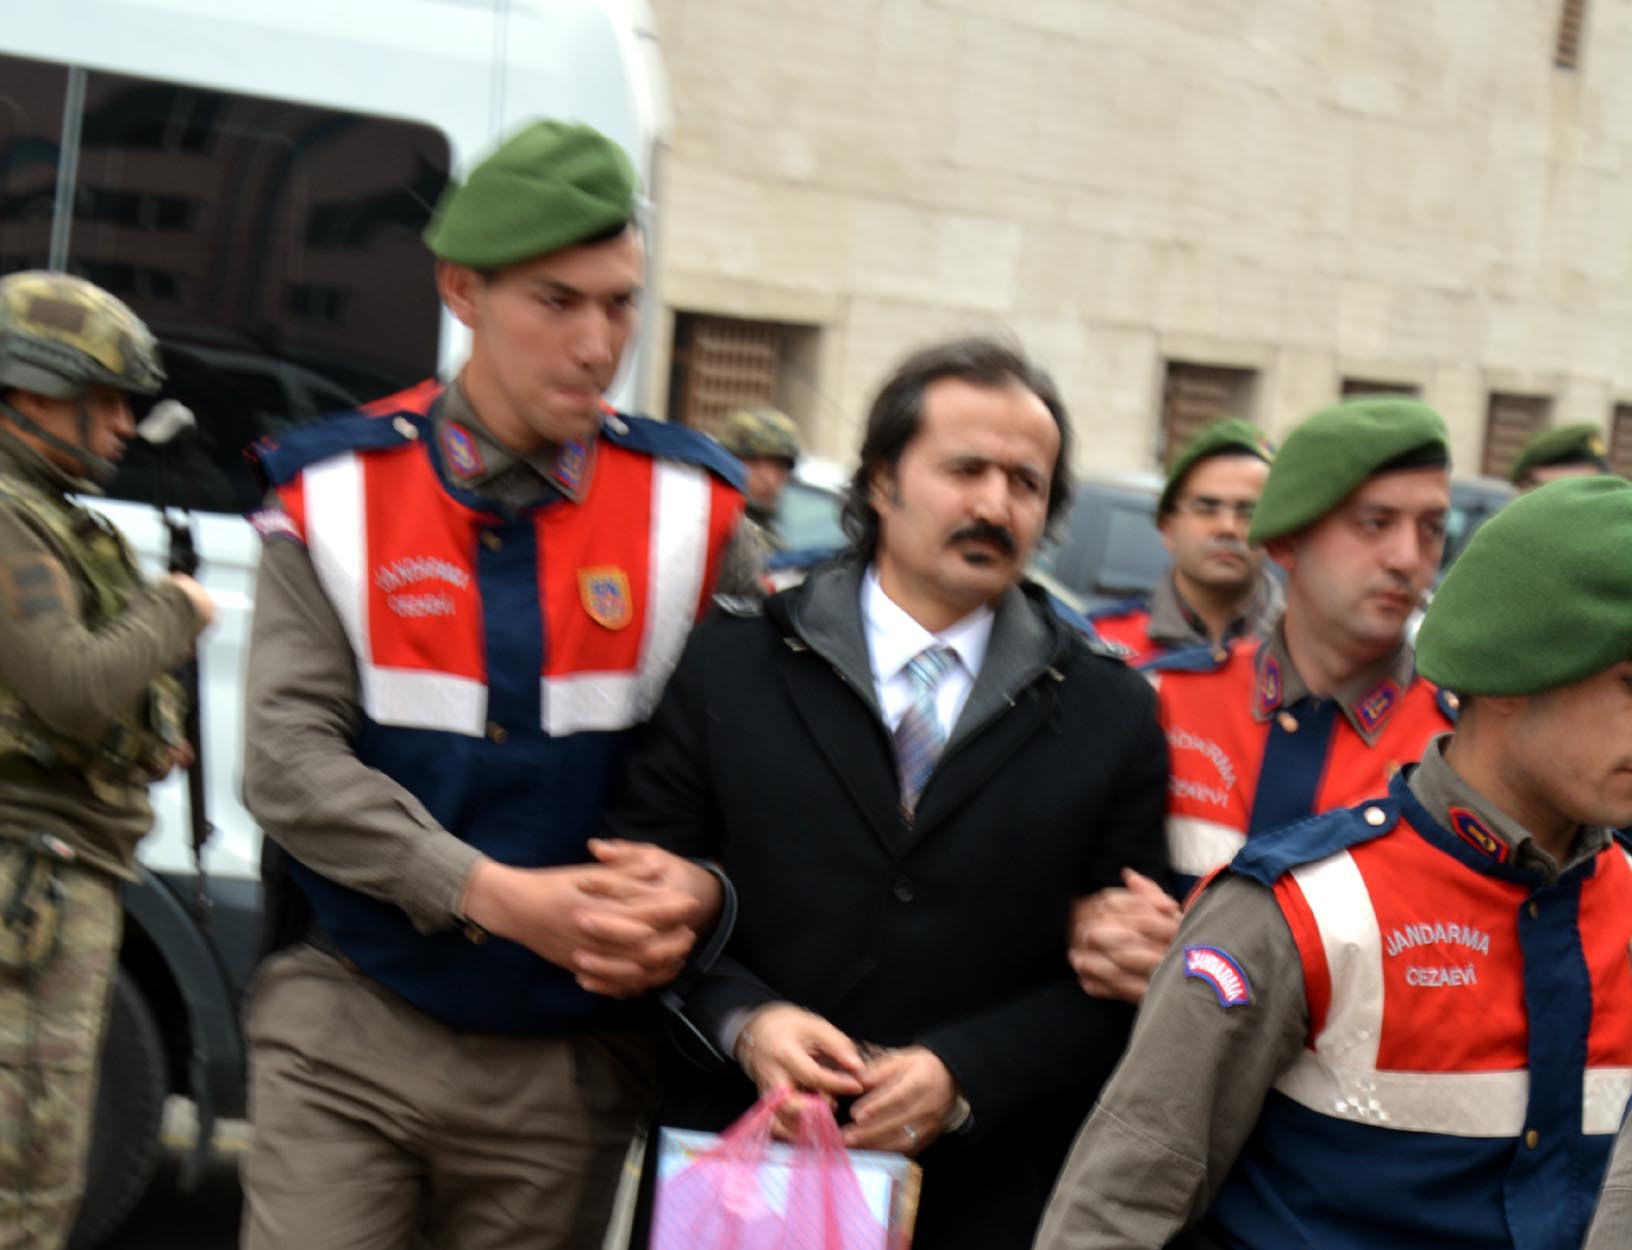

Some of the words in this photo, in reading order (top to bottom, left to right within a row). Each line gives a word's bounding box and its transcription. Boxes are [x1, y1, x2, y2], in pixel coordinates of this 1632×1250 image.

[1385, 920, 1490, 956] JANDARMA
[1188, 950, 1243, 1002] JANDARMA
[1405, 962, 1478, 988] CEZAEVİ
